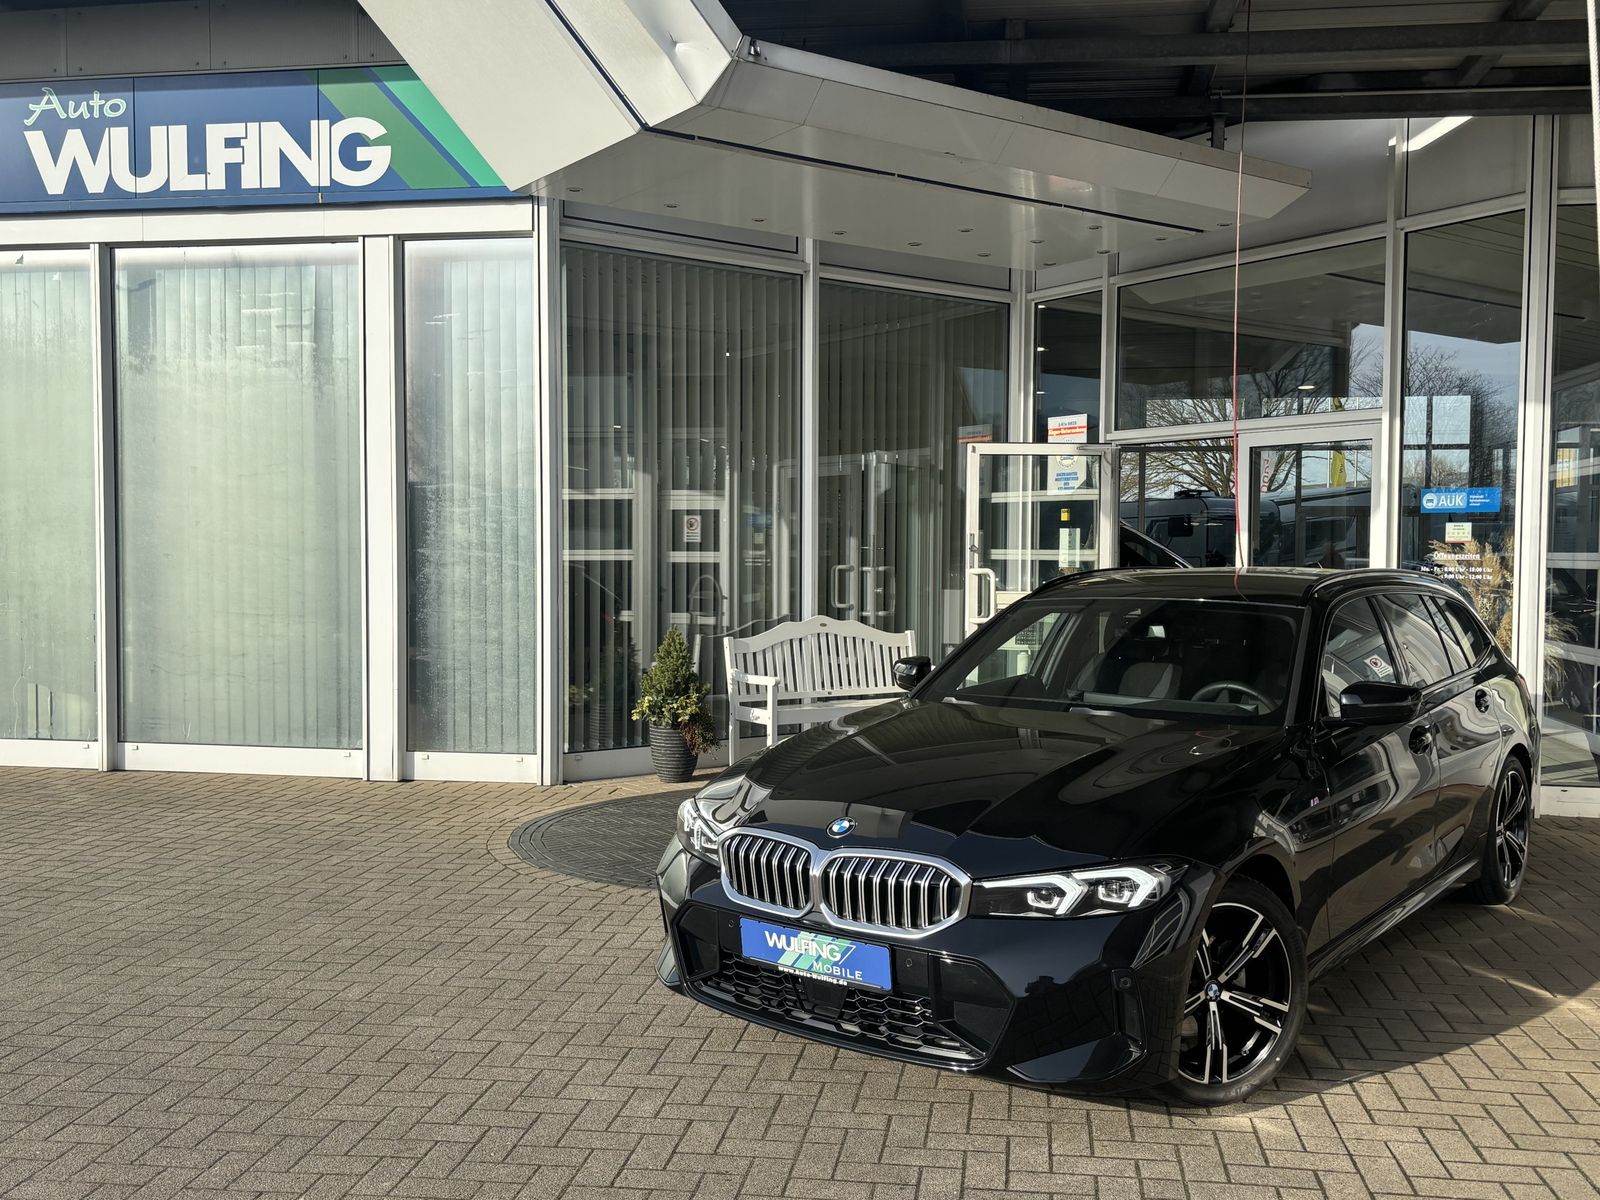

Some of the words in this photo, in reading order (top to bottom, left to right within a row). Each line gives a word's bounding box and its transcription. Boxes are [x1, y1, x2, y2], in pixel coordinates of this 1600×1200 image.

[23, 87, 127, 126] Auto
[23, 116, 392, 195] WULFING
[764, 930, 841, 962] WULFING
[812, 960, 863, 981] MOBILE
